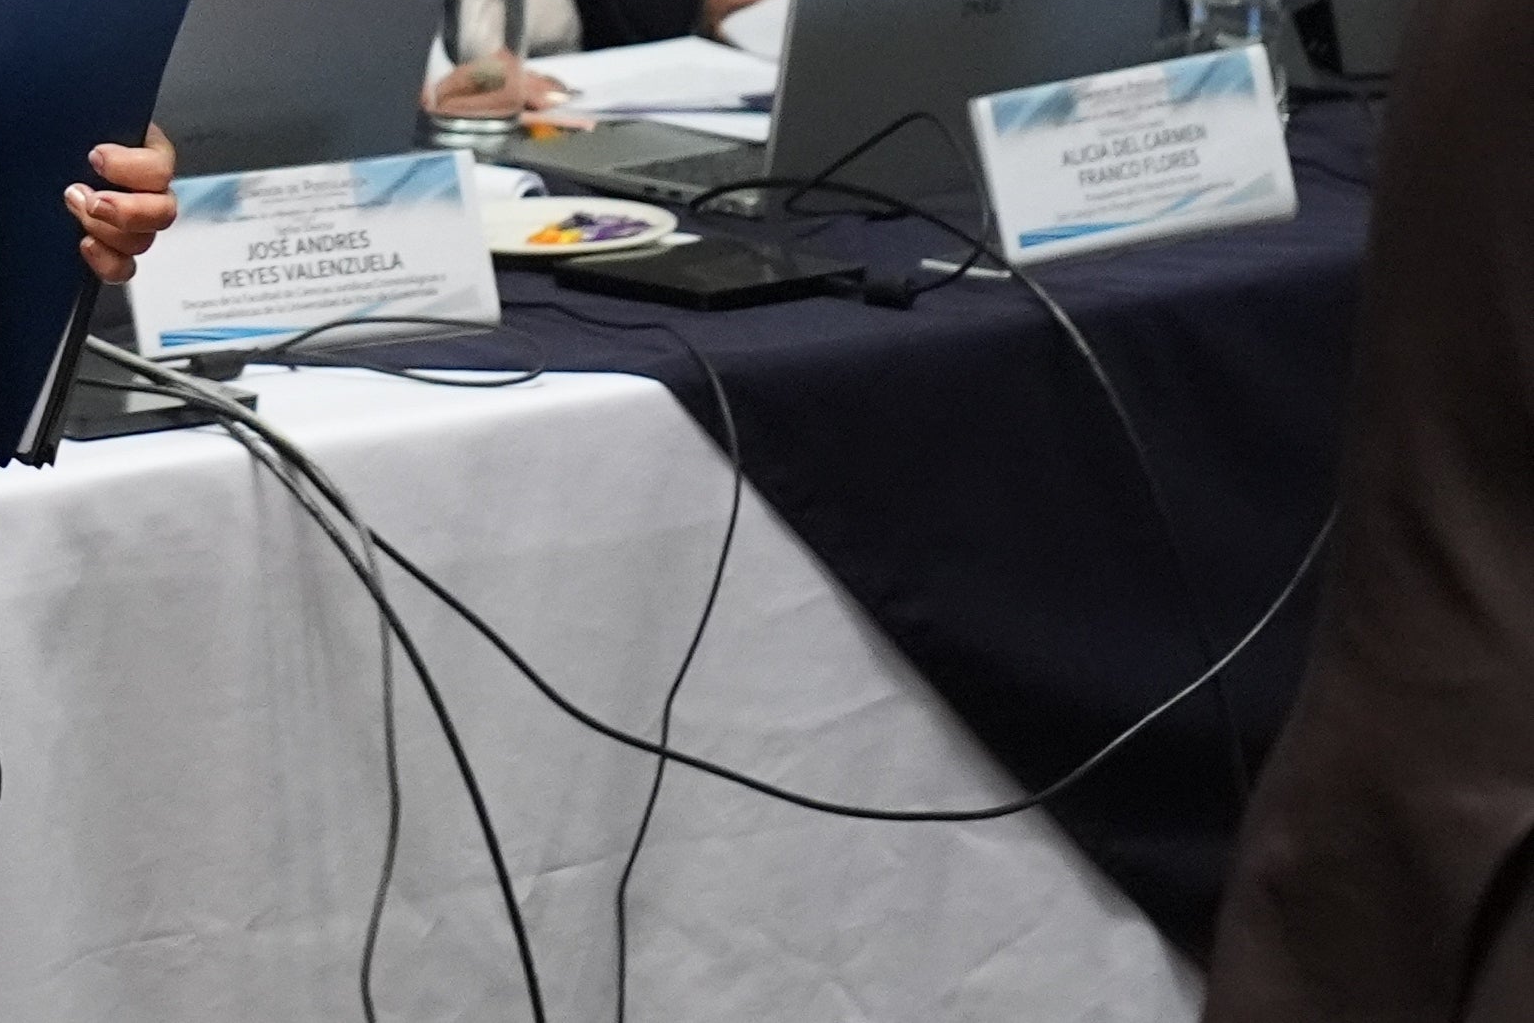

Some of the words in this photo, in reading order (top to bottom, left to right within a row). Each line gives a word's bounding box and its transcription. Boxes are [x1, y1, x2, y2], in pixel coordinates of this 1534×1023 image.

[1111, 136, 1140, 157] DEL
[1079, 160, 1141, 186] FRANCO
[1143, 149, 1200, 174] FLORES
[247, 234, 291, 261] JOSÉ
[221, 265, 280, 288] REYES
[282, 252, 404, 280] VALENZUELA
